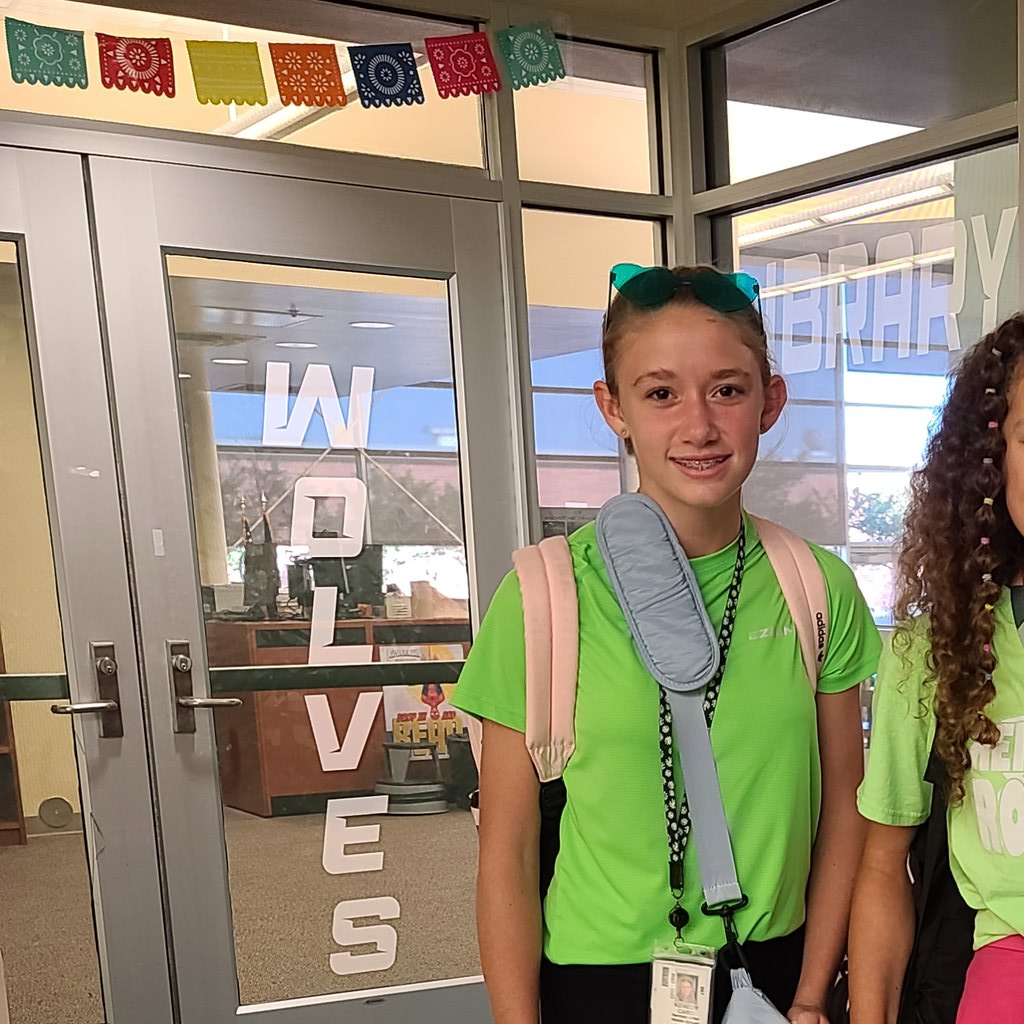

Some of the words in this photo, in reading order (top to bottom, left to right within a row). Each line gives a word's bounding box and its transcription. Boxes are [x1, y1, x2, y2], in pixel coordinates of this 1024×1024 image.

[765, 206, 1019, 375] IBRARY
[263, 361, 401, 976] WOLVES
[815, 611, 826, 650] adidas
